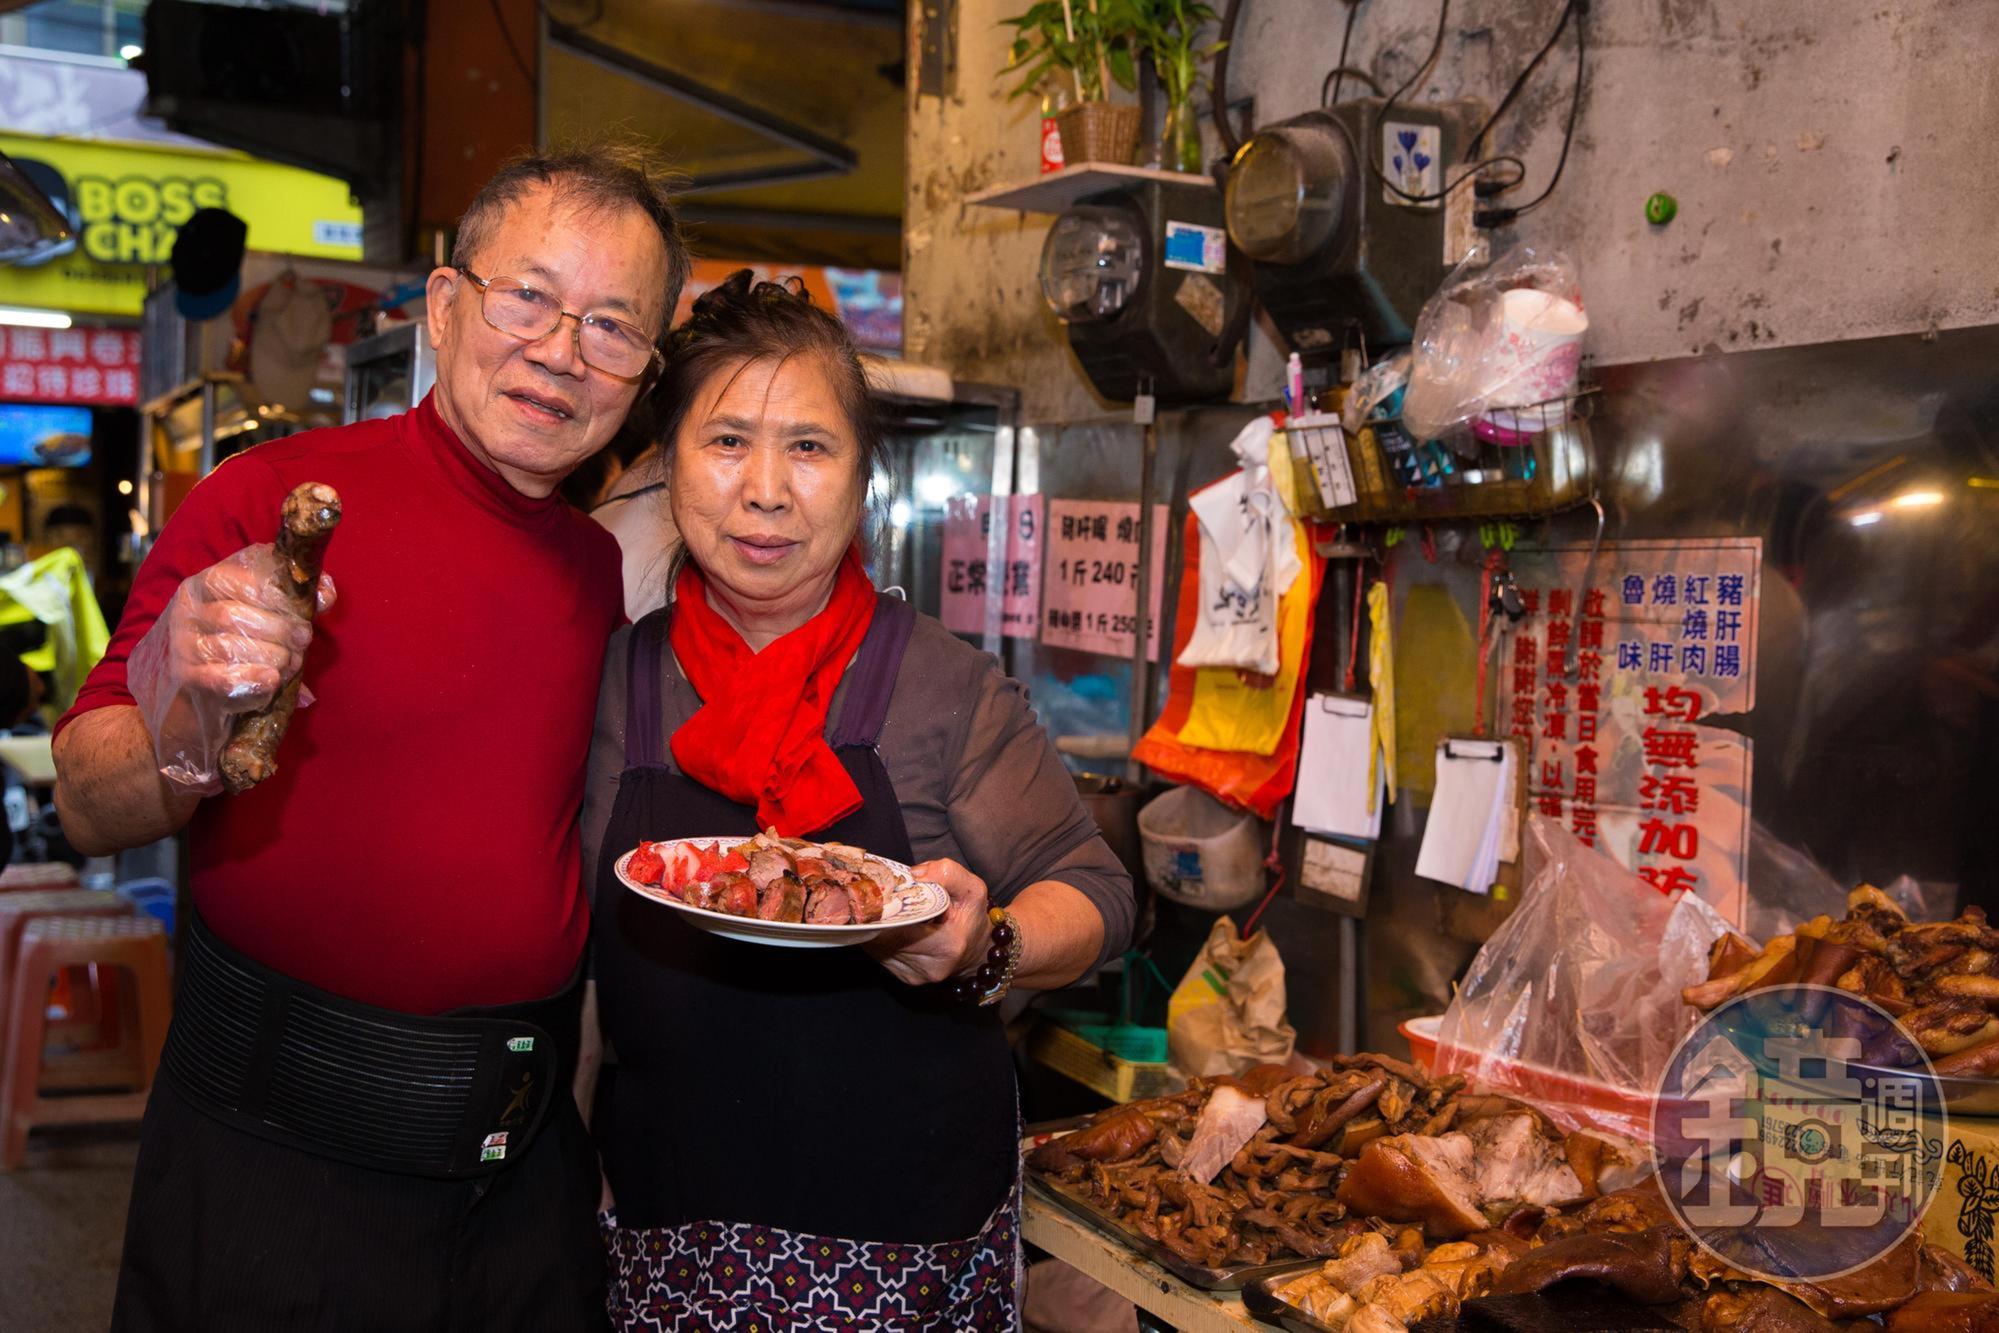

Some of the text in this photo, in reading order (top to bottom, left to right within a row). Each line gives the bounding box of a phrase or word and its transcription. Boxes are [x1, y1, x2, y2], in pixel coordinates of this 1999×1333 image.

[78, 177, 226, 226] BOSS
[947, 560, 1030, 597] 正常業
[1618, 574, 1644, 672] 魯味
[1649, 574, 1676, 673] 燒肝
[1681, 574, 1709, 675] 紅燒肉
[1714, 574, 1743, 677] 豬肝腸
